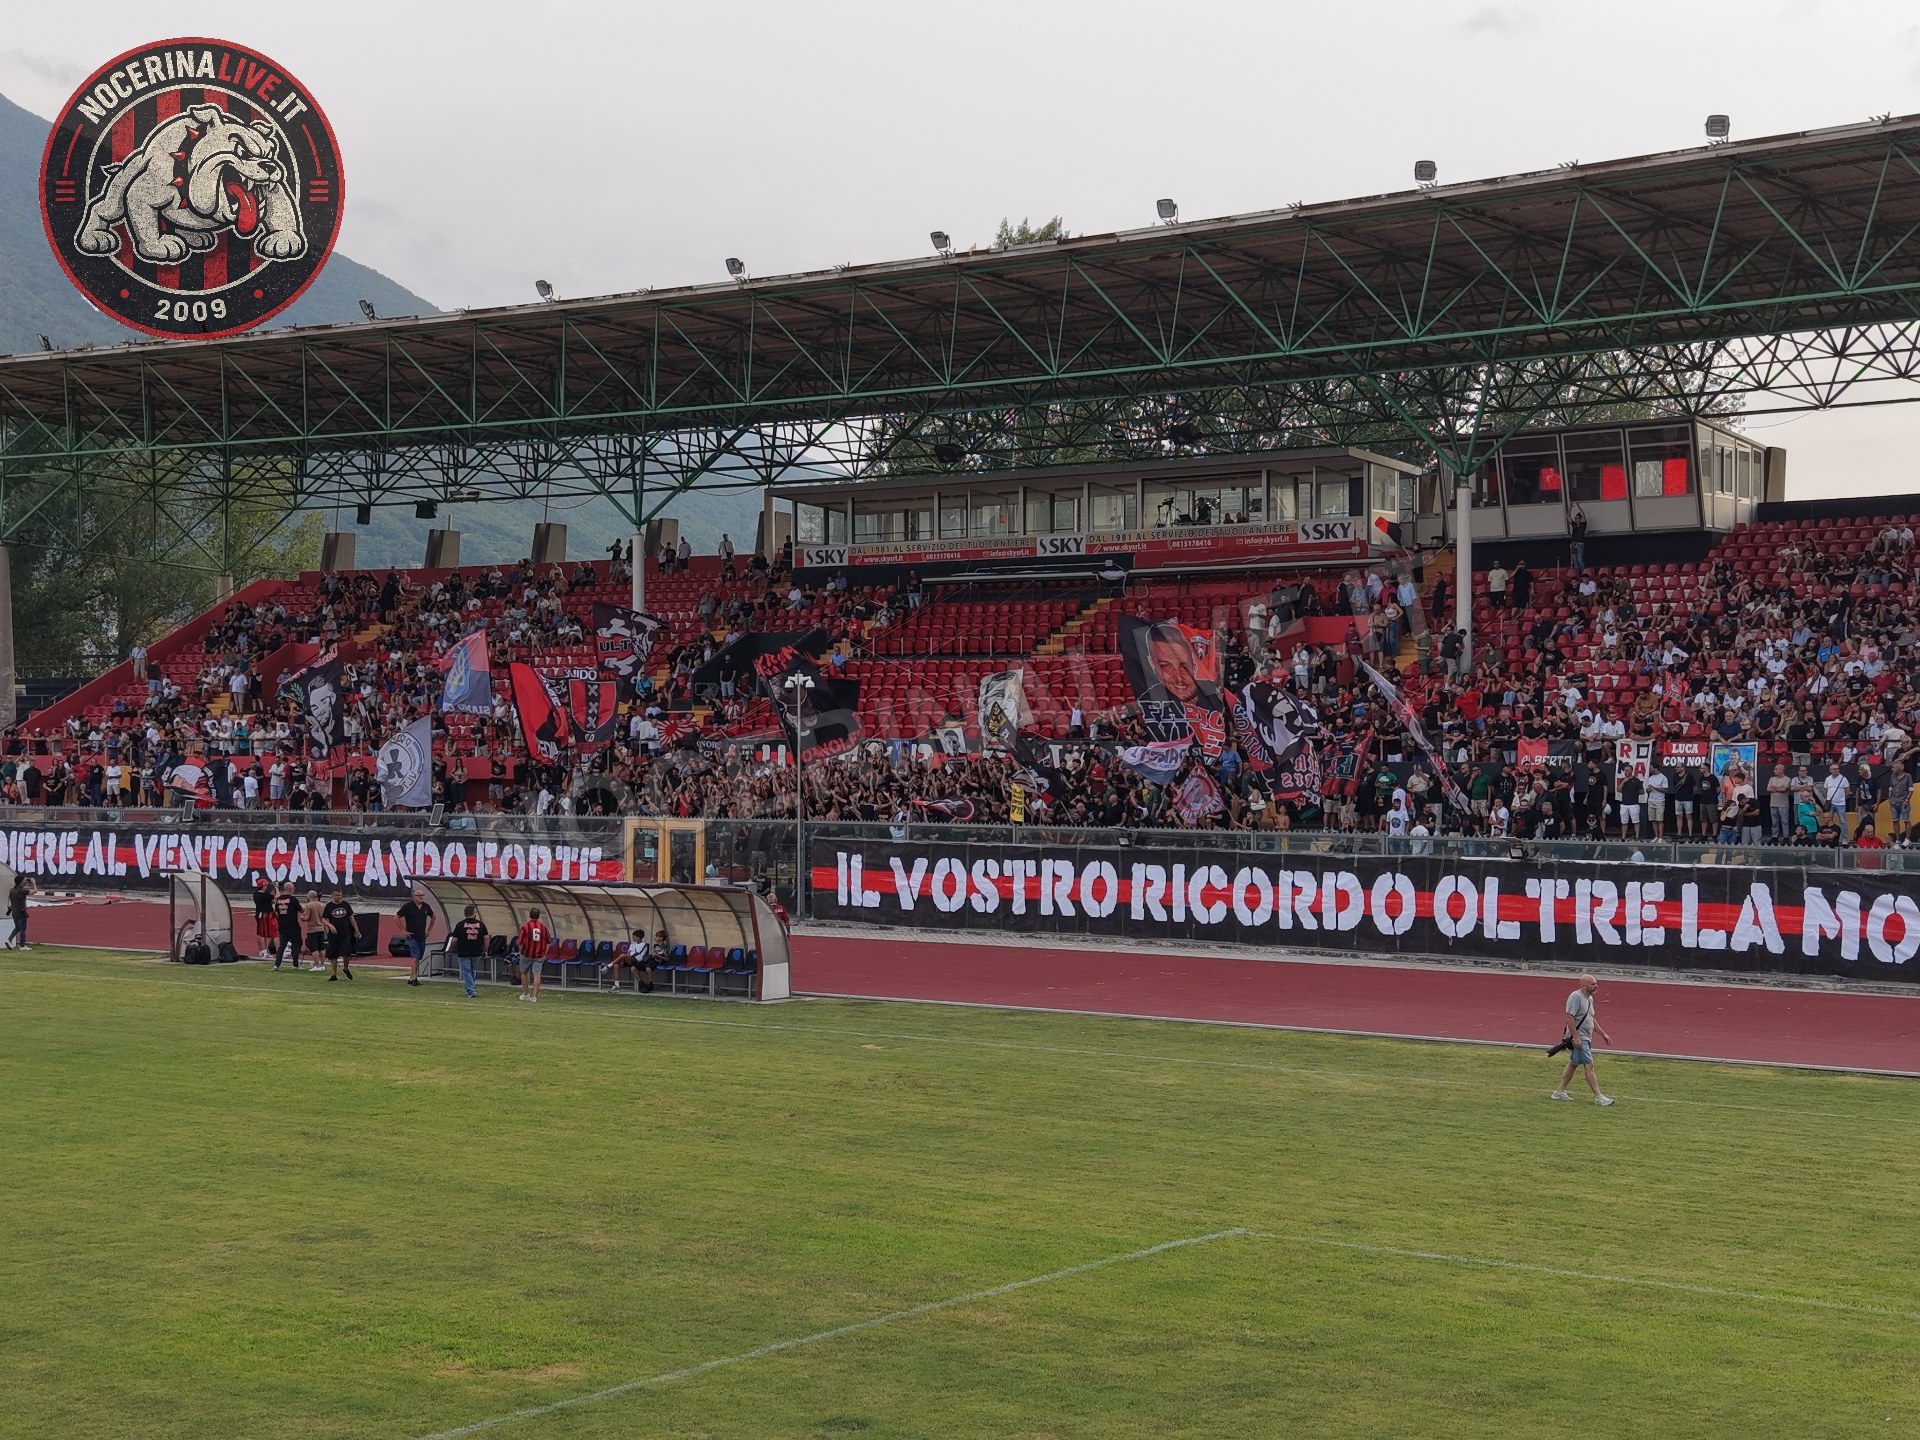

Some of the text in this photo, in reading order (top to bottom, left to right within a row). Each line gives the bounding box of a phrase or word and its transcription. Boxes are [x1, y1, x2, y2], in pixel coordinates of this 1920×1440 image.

[1089, 535, 1106, 543] DAL
[1111, 533, 1132, 542] 1981
[1136, 532, 1146, 541] AL
[1151, 529, 1194, 540] SERVIZIO
[1198, 527, 1215, 537] DEL
[1219, 526, 1238, 536] TUO
[1312, 522, 1351, 540] SKY
[907, 542, 946, 552] SERVIZIO
[949, 541, 964, 550] DEL
[968, 540, 985, 549] TUO
[1049, 537, 1083, 553] SKY
[815, 549, 846, 564] SKY
[1672, 743, 1698, 754] LUCA
[1663, 756, 1683, 767] CON
[83, 831, 126, 876] AL
[265, 836, 467, 888] CANTANDO
[837, 851, 881, 907] IL
[889, 857, 1118, 917] VOSTRO
[1131, 862, 1416, 935] RICORDO
[1434, 875, 1665, 946] OLTRE
[1681, 882, 1785, 954] LA
[532, 927, 540, 942] 6
